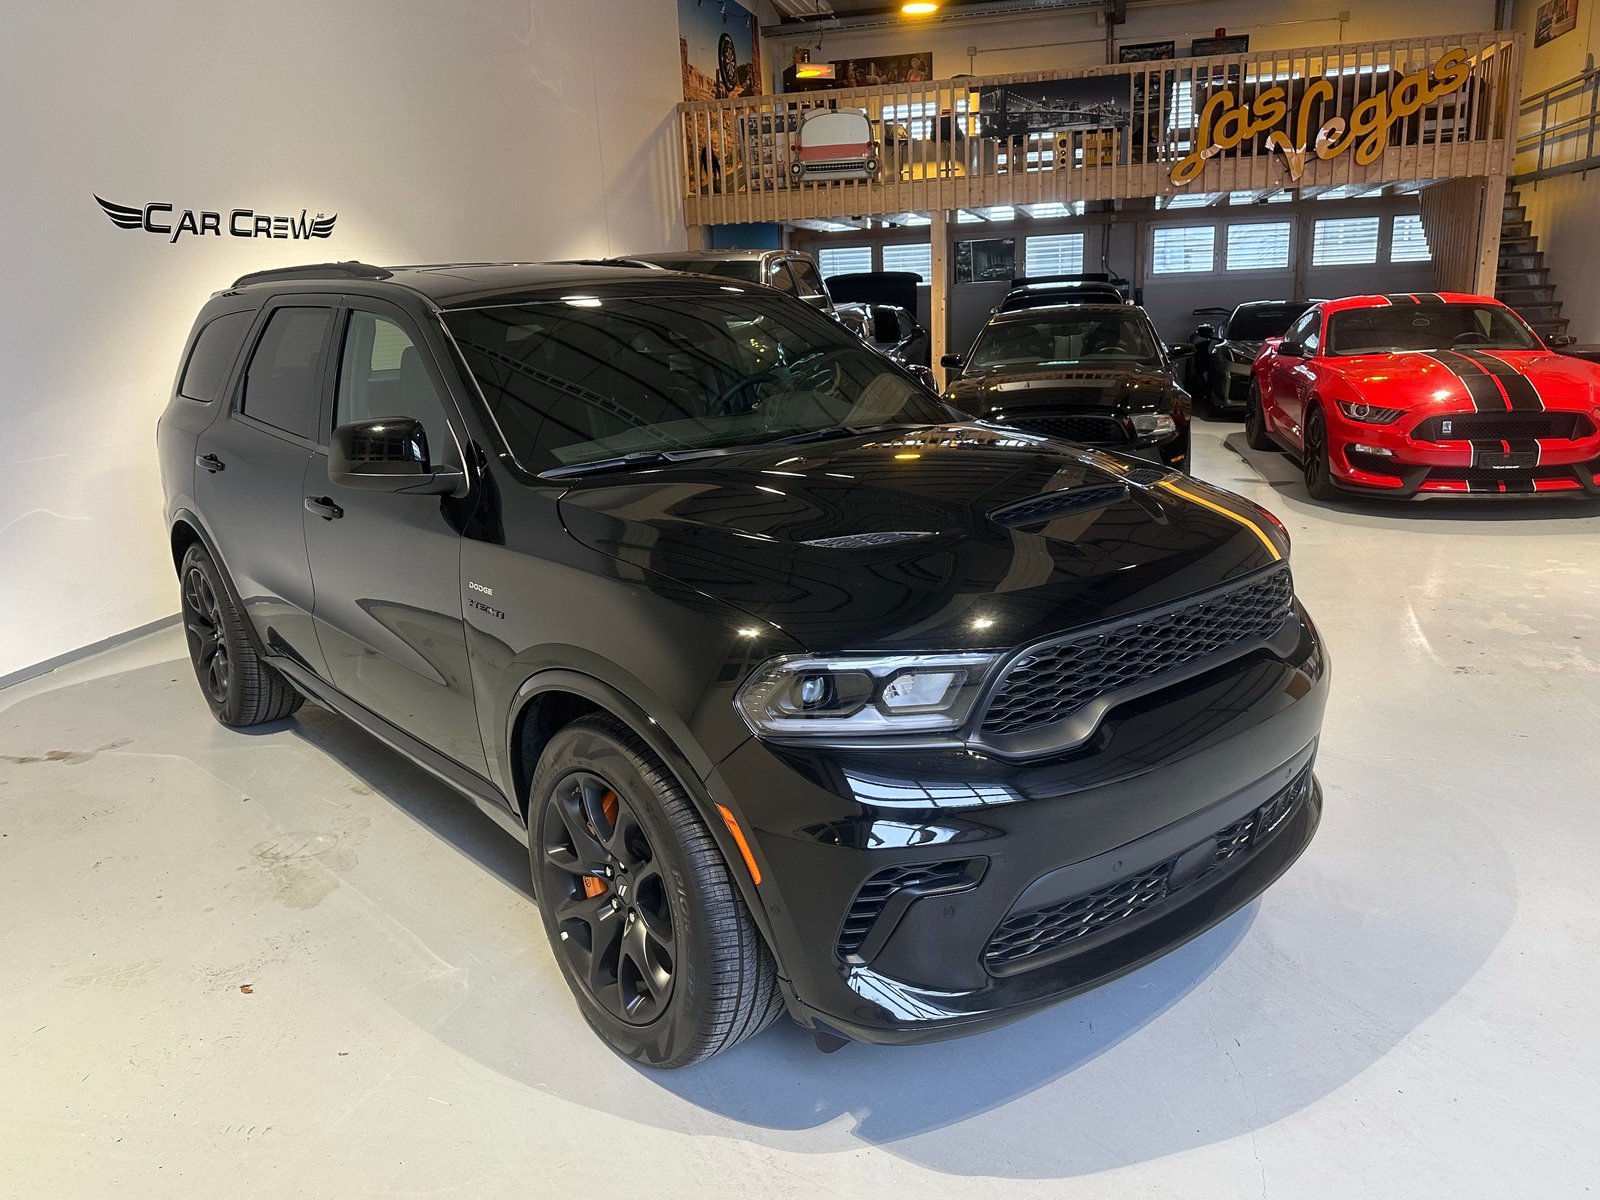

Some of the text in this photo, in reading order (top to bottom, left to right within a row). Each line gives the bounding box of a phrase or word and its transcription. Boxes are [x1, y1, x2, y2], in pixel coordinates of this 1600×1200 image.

[1168, 48, 1471, 187] Las Vegas
[143, 202, 221, 244] CAR
[229, 208, 315, 240] CREW
[468, 581, 493, 596] DODGE
